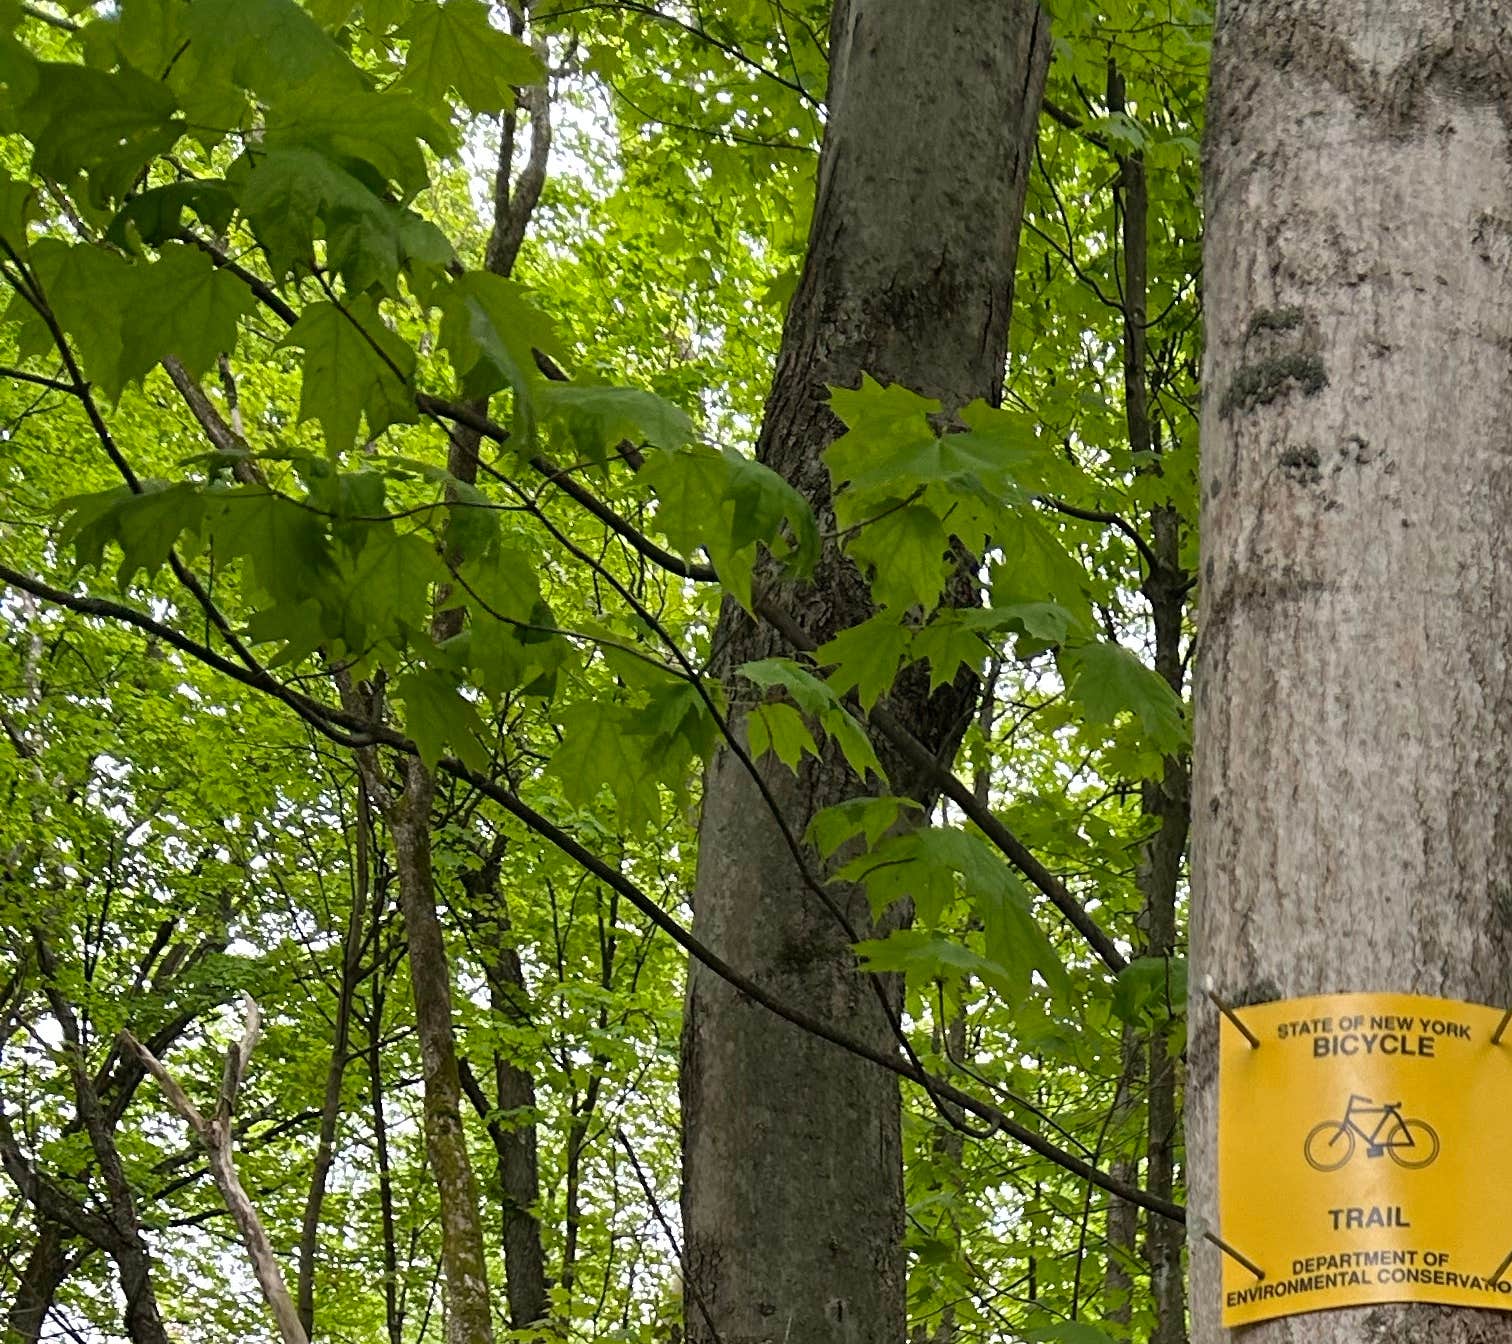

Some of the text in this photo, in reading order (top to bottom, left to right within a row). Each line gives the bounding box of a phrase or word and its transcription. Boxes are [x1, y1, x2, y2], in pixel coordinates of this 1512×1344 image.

[1278, 1015, 1472, 1041] STATE OF NEW YORK
[1313, 1034, 1436, 1058] BICYCLE
[1328, 1206, 1411, 1231] TRAIL
[1292, 1251, 1450, 1276] DEPARTMENT OF
[1226, 1271, 1373, 1308] ENVIRONMENTAL
